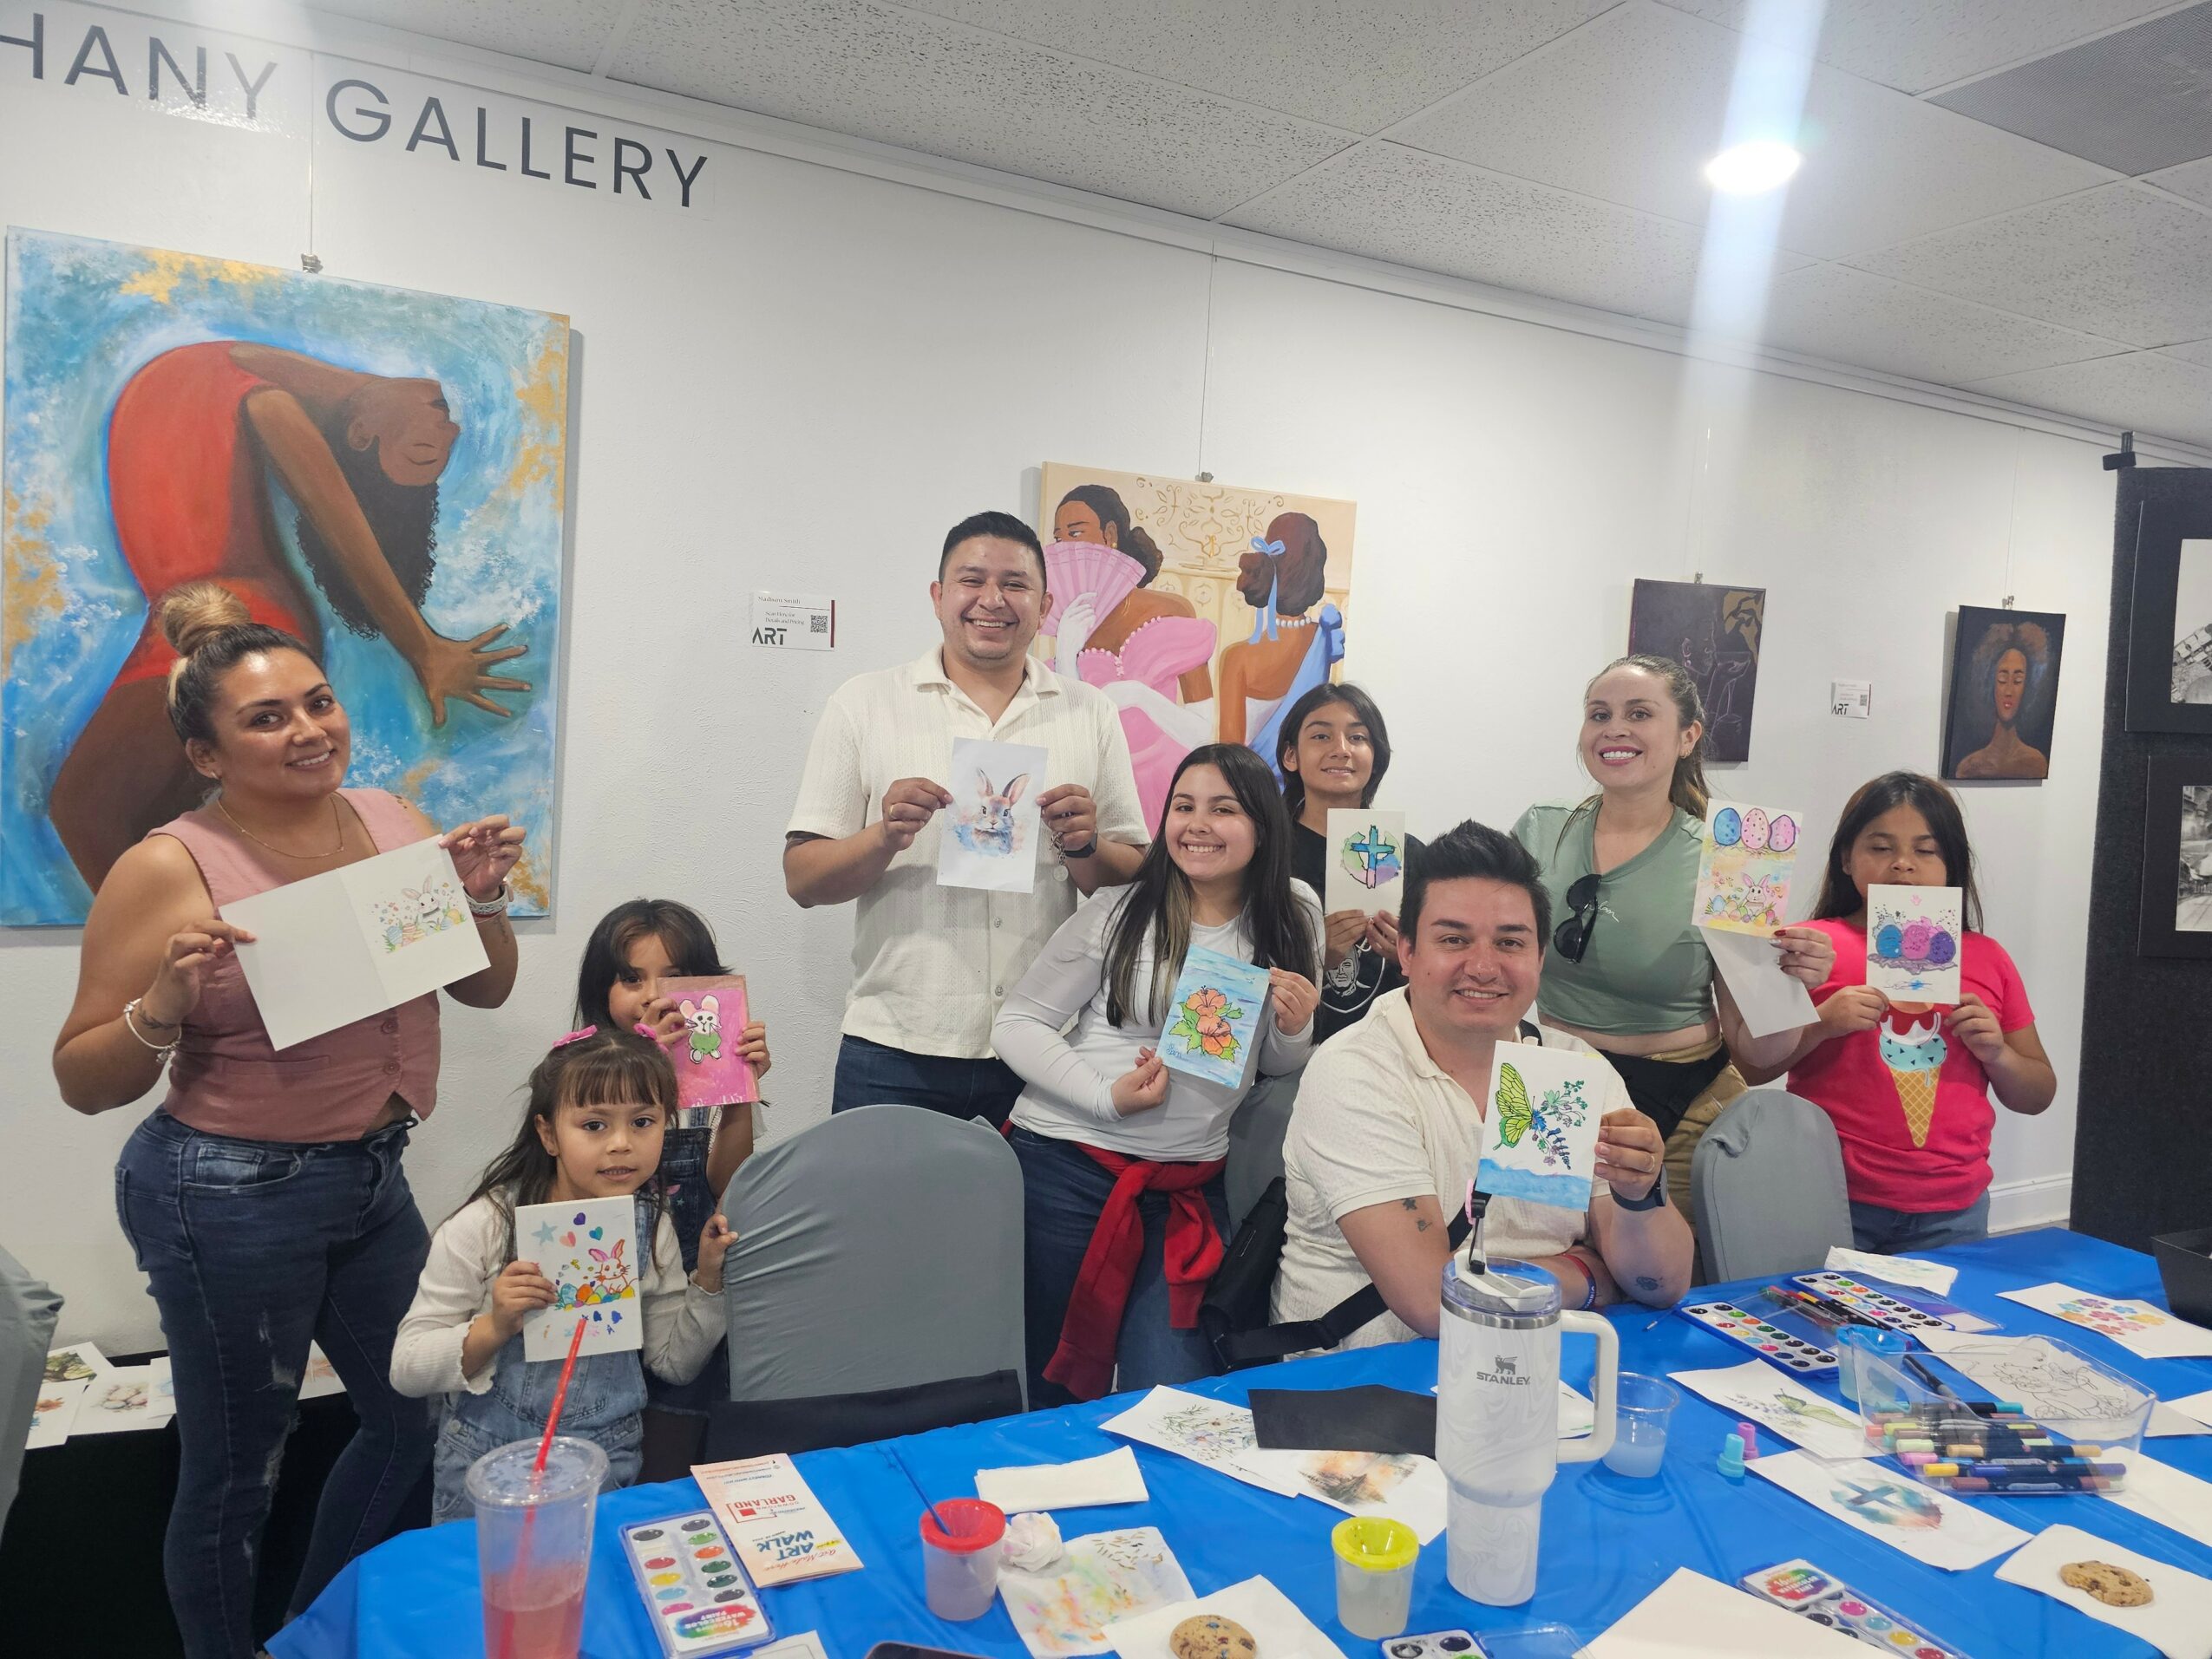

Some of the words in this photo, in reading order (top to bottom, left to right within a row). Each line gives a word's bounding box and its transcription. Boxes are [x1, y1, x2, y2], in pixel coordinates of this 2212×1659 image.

[325, 79, 709, 208] GALLERY
[751, 626, 788, 646] ART
[1831, 703, 1849, 715] ART
[1476, 1371, 1531, 1386] STANLEY
[734, 1494, 796, 1509] GARLAND
[756, 1530, 815, 1553] WALK
[777, 1542, 814, 1561] ART
[684, 1611, 746, 1630] WATERCOLOR
